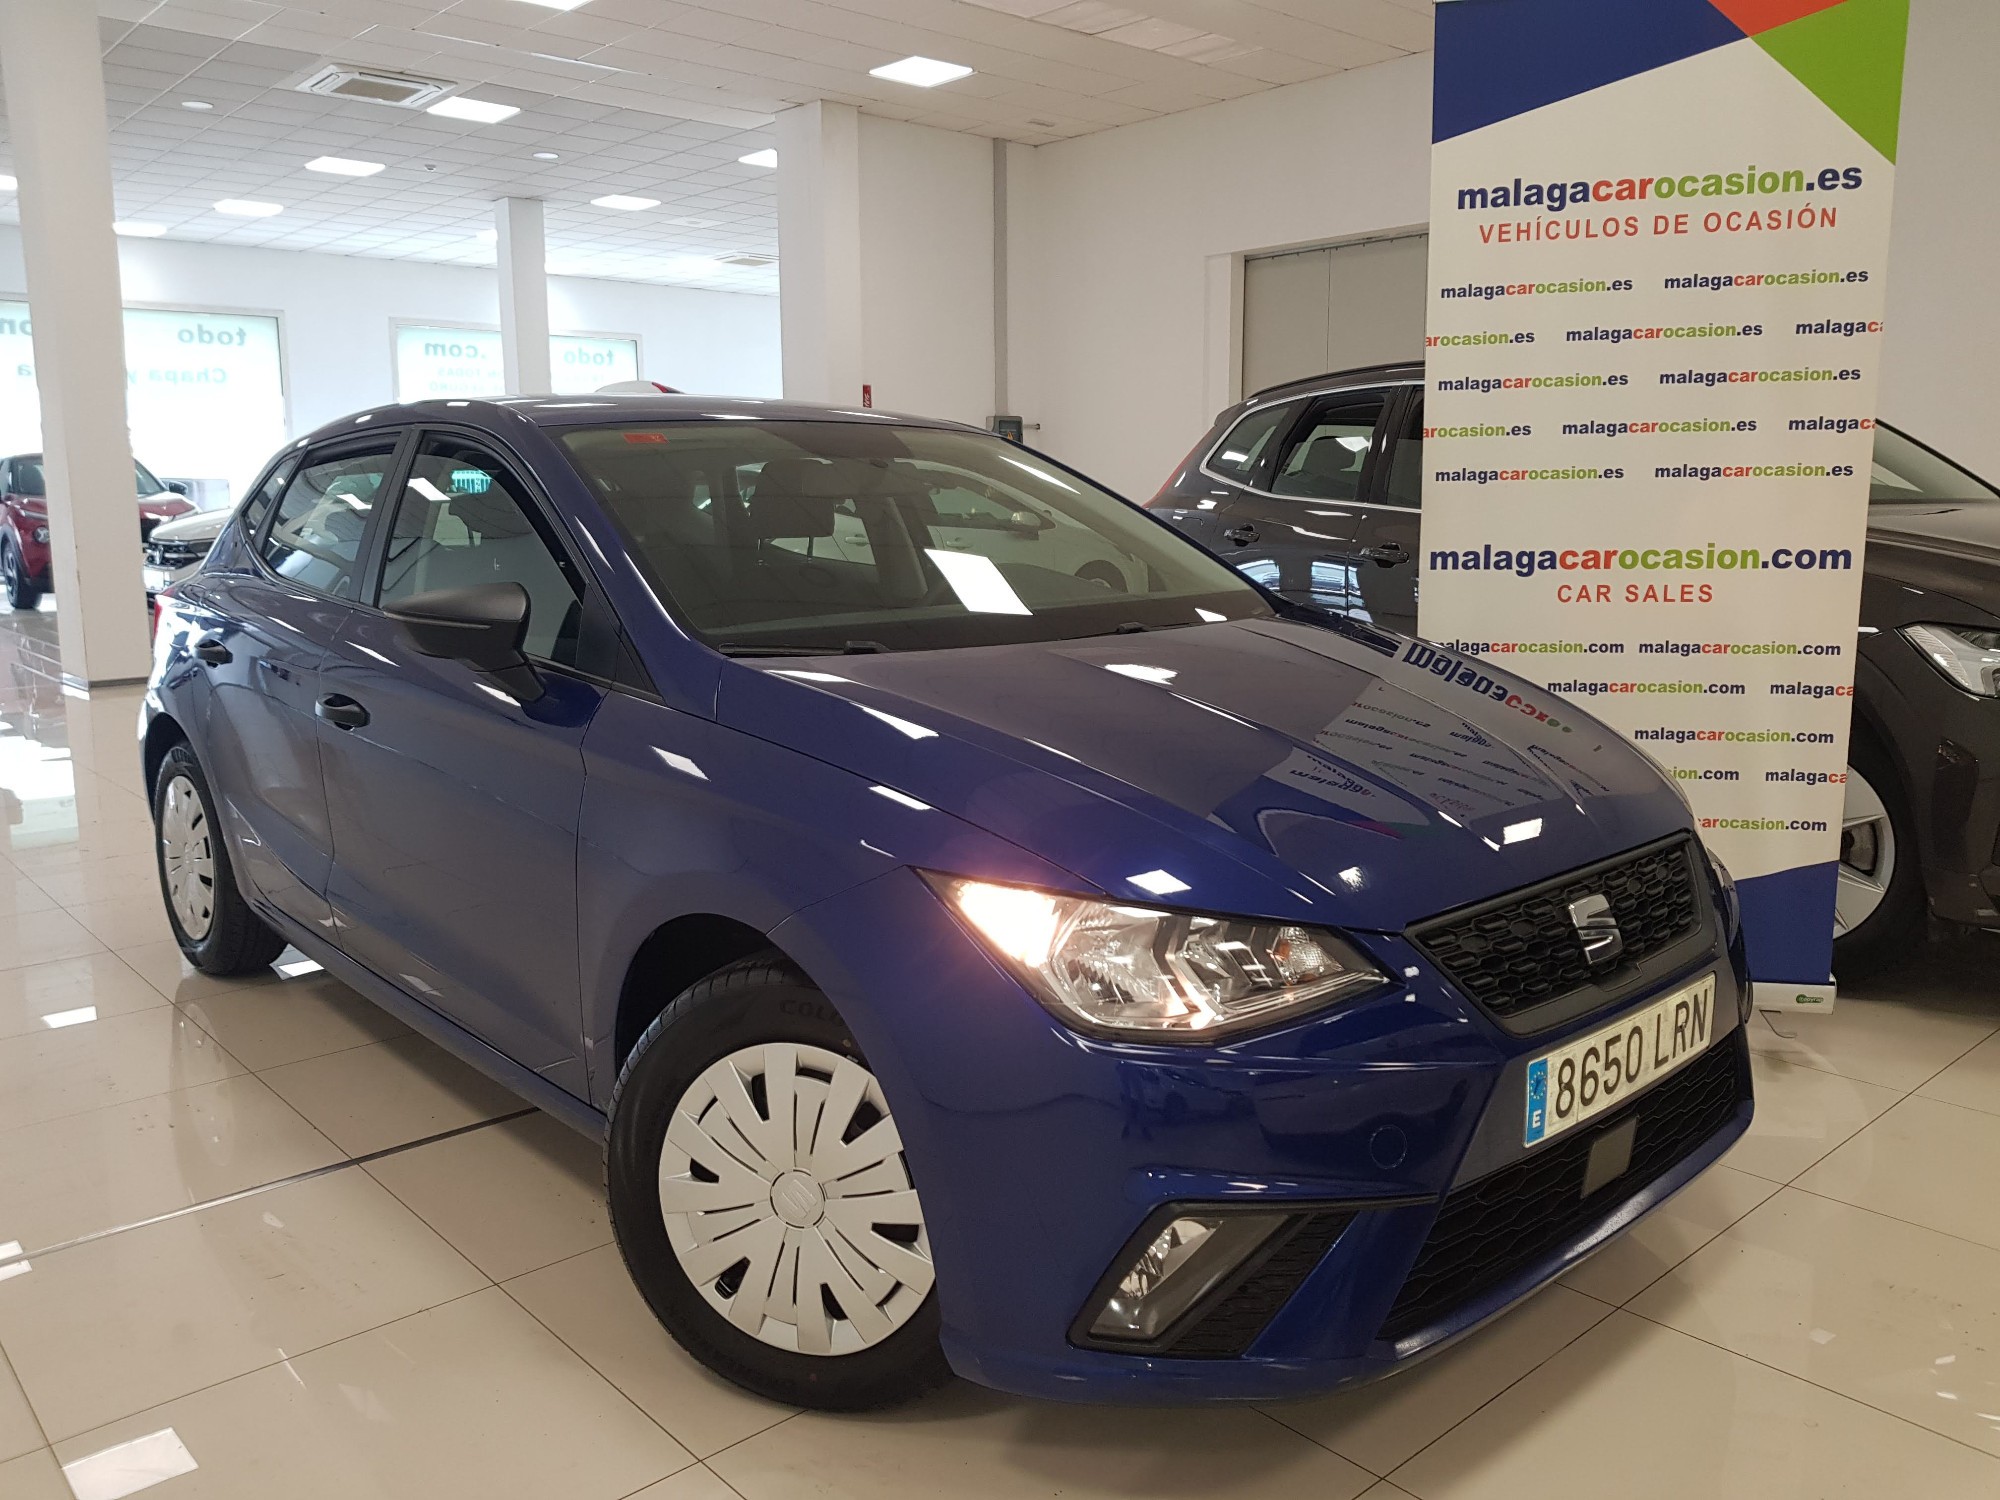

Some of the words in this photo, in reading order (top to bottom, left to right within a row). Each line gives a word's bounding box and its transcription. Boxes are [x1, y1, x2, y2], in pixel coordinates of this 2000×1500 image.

[1457, 165, 1863, 211] malagacarocasion.es
[1479, 216, 1638, 243] VEHÍCULOS
[1653, 214, 1689, 236] DE
[1703, 202, 1837, 233] OCASIÓN
[1440, 278, 1633, 300] malagacarocasion.es
[1664, 269, 1869, 291] malagacarocasion.es
[1565, 322, 1763, 344] malagacarocasion.es
[1437, 372, 1629, 393] malagacarocasion.es
[1659, 367, 1861, 388] malagacarocasion.es
[1562, 417, 1757, 437] malagacarocasion.es
[1435, 466, 1624, 484] malagacarocasion.es
[1654, 462, 1853, 481] malagacarocasion.es
[1429, 542, 1852, 577] malagacarocasion.com
[1557, 584, 1612, 603] CAR
[1624, 584, 1713, 603] SALES
[1439, 640, 1624, 656] alagacarocasion.com
[1638, 640, 1841, 657] malagacarocasion.com
[1547, 679, 1746, 696] malagacarocasion.com
[1634, 727, 1835, 745] malagacarocasion.com
[1531, 1109, 1542, 1129] E
[1555, 1025, 1644, 1120] 8650
[1653, 988, 1709, 1070] LRN
